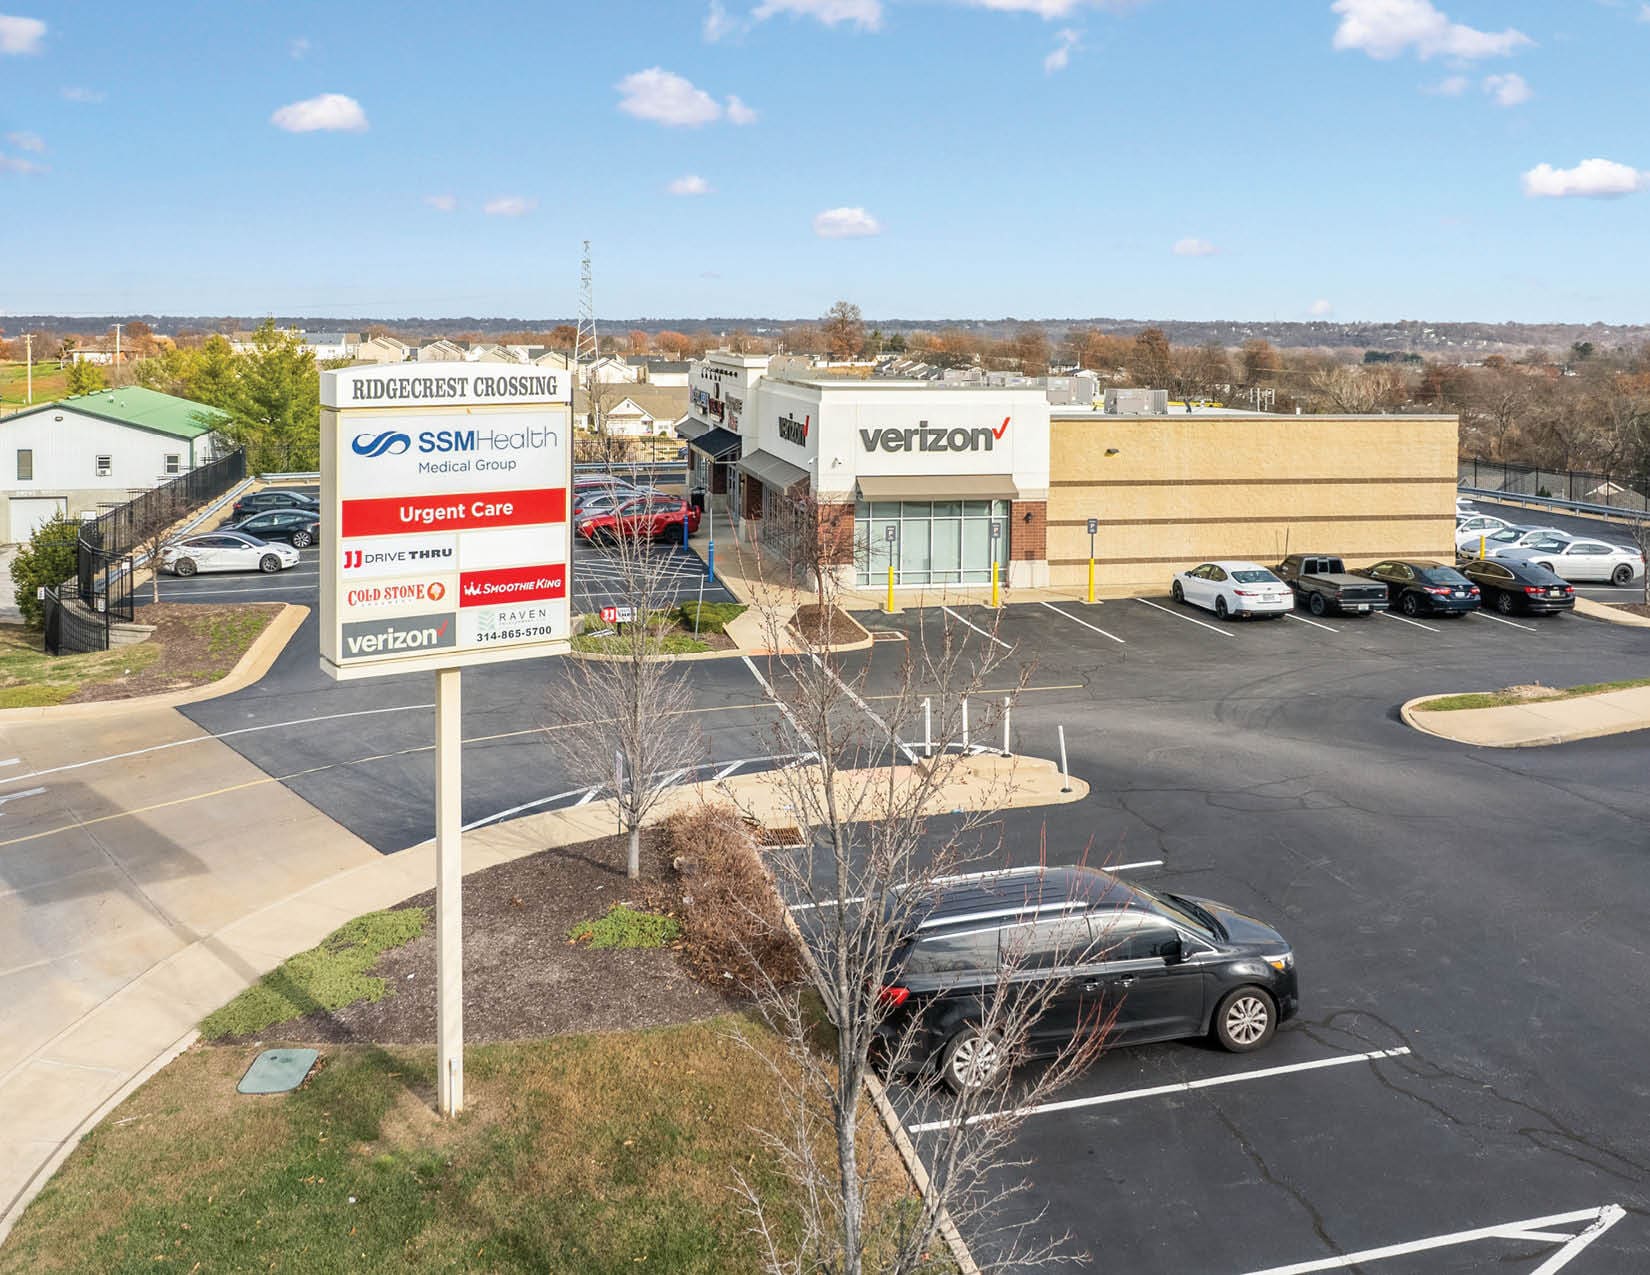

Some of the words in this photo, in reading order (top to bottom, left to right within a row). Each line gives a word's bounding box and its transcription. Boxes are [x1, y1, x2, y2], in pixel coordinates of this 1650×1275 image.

[352, 377, 468, 400] RIDGECREST
[473, 375, 558, 397] CROSSING
[779, 413, 806, 448] verizon
[859, 421, 993, 452] verizon
[418, 460, 471, 474] Medical
[475, 459, 517, 472] Group
[400, 504, 466, 523] Urgent
[471, 502, 513, 516] Care
[344, 550, 362, 569] JJ
[365, 552, 406, 564] DRIVE
[408, 548, 453, 560] THRU
[348, 588, 381, 607] COLD
[384, 584, 425, 601] STONE
[498, 608, 548, 622] RAVEN
[347, 627, 437, 654] verizon
[476, 626, 552, 642] 314-865-5700
